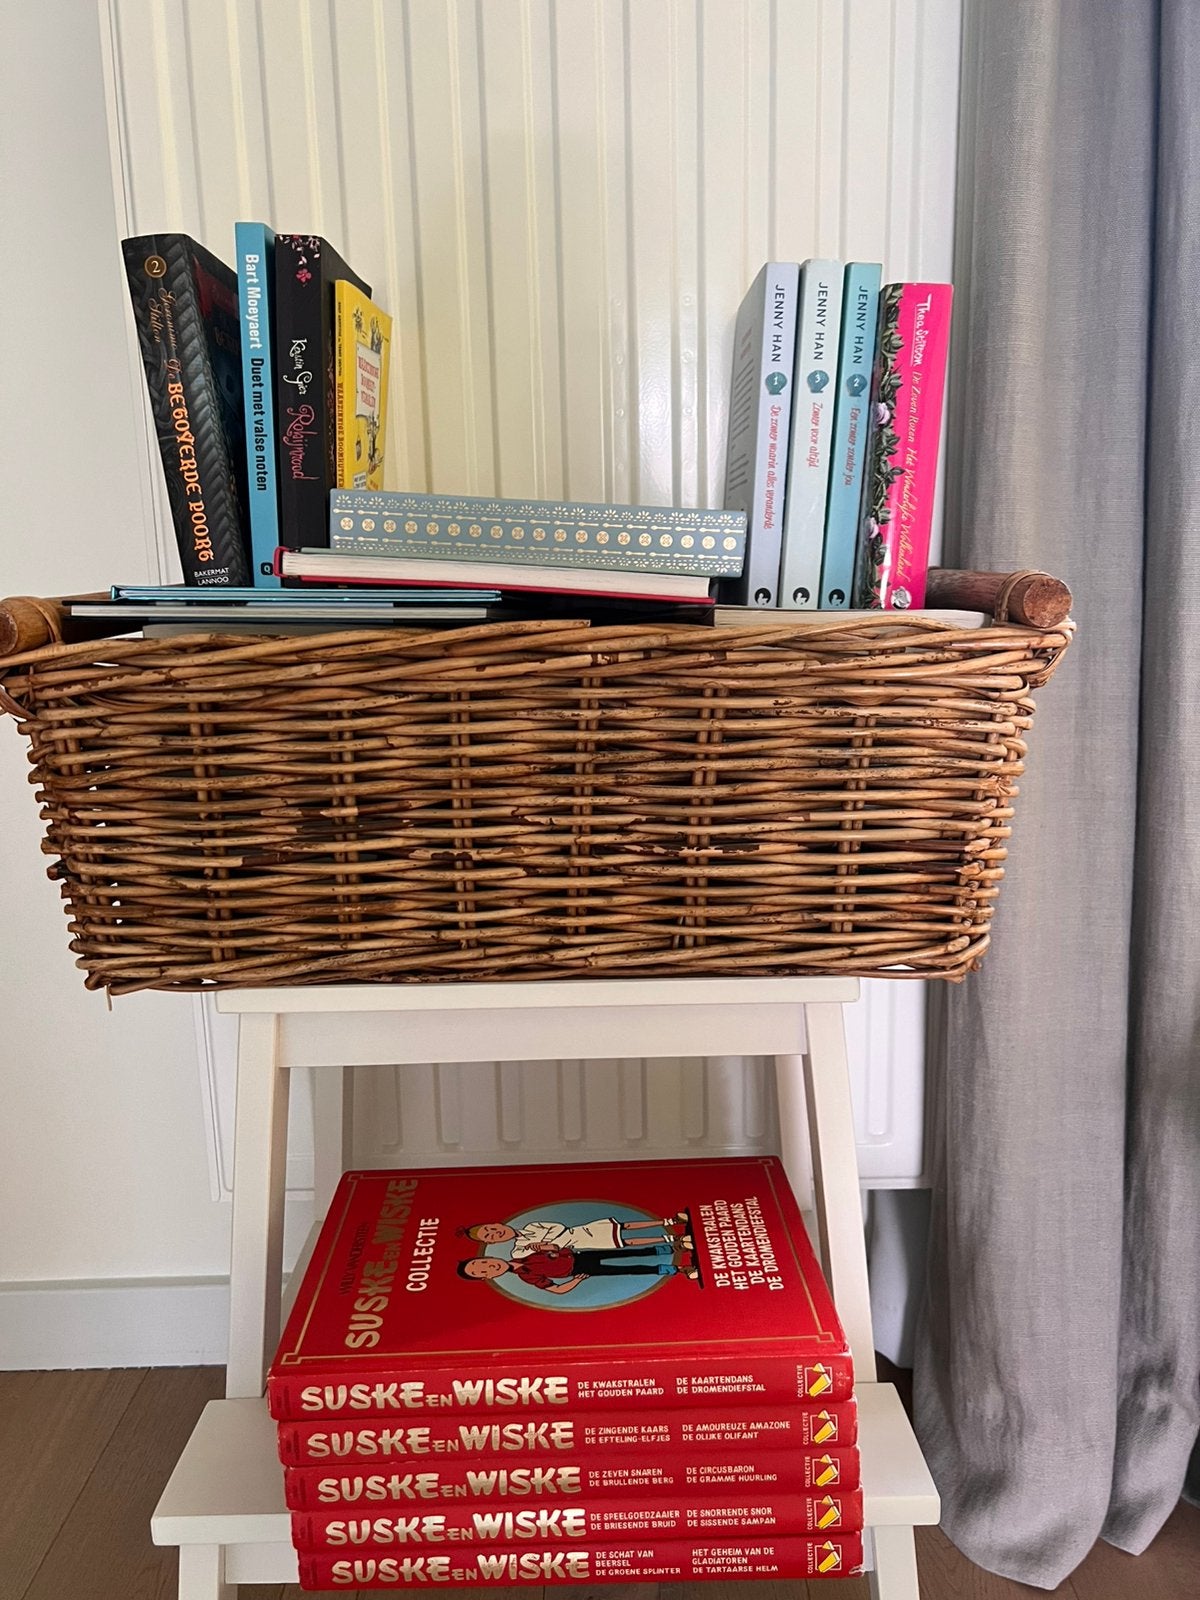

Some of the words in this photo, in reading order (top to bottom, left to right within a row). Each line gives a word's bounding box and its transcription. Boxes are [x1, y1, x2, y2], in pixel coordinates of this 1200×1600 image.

[152, 260, 161, 273] 2
[246, 254, 259, 283] Bart
[773, 284, 785, 329] JENNY
[816, 282, 828, 327] JENNY
[856, 286, 868, 331] JENNY
[916, 293, 932, 329] Thea
[246, 286, 262, 350] Moeyaert
[772, 334, 782, 362] HAN
[814, 332, 825, 360] HAN
[853, 336, 864, 364] HAN
[913, 329, 929, 367] Stilton
[251, 358, 264, 386] Duet
[283, 371, 313, 395] Gier
[912, 371, 922, 385] De
[252, 388, 265, 416] met
[770, 405, 781, 417] De
[811, 402, 823, 426] Zomer
[850, 407, 861, 420] Een
[253, 418, 267, 456] valse
[283, 404, 320, 480] Robijnrood
[769, 418, 778, 444] zomer
[811, 428, 820, 446] voor
[848, 422, 858, 445] zomer
[768, 443, 778, 469] waarin
[806, 446, 820, 468] altijd
[846, 447, 855, 475] zonder
[906, 447, 918, 465] Het
[256, 458, 267, 491] noten
[767, 470, 778, 488] alles
[843, 475, 854, 486] jou
[764, 489, 775, 529] veranderde
[188, 500, 214, 562] POORT
[194, 567, 229, 577] BAKERMAT
[198, 576, 229, 586] LANNOO
[714, 1199, 732, 1228] PAARD
[699, 1204, 727, 1270] KWAKSTRALEN
[730, 1203, 760, 1267] KAARTENDANS
[745, 1196, 779, 1273] DROMENDIEFSTAL
[405, 1218, 440, 1292] COLLECTIE
[721, 1230, 743, 1268] GOUDEN
[344, 1260, 398, 1349] SUSKE
[372, 1179, 418, 1245] WISKE
[714, 1272, 731, 1288] DE
[731, 1270, 749, 1290] HET
[748, 1270, 766, 1285] DE
[766, 1276, 785, 1291] DE
[577, 1381, 590, 1390] DE
[592, 1378, 656, 1389] KWAKSTRALEN
[676, 1377, 688, 1385] DE
[691, 1375, 754, 1385] KAARTENDANS
[676, 1386, 689, 1394] DE
[691, 1384, 766, 1393] DROMENDIEFSTAL
[300, 1381, 425, 1412] SUSKE
[425, 1394, 453, 1408] EN
[452, 1376, 569, 1406] WISKE
[578, 1390, 595, 1398] HET
[597, 1388, 633, 1398] GOUDEN
[635, 1387, 665, 1396] PAARD
[585, 1427, 596, 1436] DE
[598, 1426, 639, 1435] ZINGENDE
[641, 1425, 669, 1433] KAARS
[682, 1424, 693, 1432] DE
[695, 1422, 747, 1432] AMOUREUZE
[750, 1421, 791, 1430] AMAZONE
[682, 1433, 693, 1441] DE
[695, 1432, 722, 1441] OLIJKE
[724, 1432, 759, 1440] OLIFANT
[307, 1427, 431, 1458] SUSKE
[432, 1439, 459, 1452] EN
[458, 1421, 575, 1451] WISKE
[585, 1436, 596, 1445] DE
[599, 1434, 671, 1444] EFTELING-ELFJES
[588, 1471, 600, 1479] DE
[602, 1469, 629, 1478] ZEVEN
[631, 1468, 663, 1477] SNAREN
[686, 1466, 697, 1475] DE
[699, 1465, 755, 1474] CIRCUSBARON
[686, 1476, 697, 1484] DE
[699, 1475, 736, 1483] GRAMME
[738, 1473, 778, 1482] HUURLING
[317, 1472, 440, 1503] SUSKE
[440, 1484, 467, 1498] EN
[466, 1466, 582, 1497] WISKE
[589, 1479, 600, 1487] DE
[602, 1477, 650, 1486] BRULLENDE
[652, 1476, 674, 1484] BERG
[590, 1513, 601, 1521] DE
[603, 1510, 680, 1520] SPEELGOEDZAAIER
[686, 1509, 698, 1518] DE
[700, 1508, 749, 1517] SNORRENDE
[750, 1507, 773, 1516] SNOR
[700, 1518, 739, 1527] SISSENDE
[741, 1517, 776, 1525] SAMPAN
[325, 1515, 446, 1546] SUSKE
[447, 1527, 473, 1541] EN
[471, 1508, 587, 1540] WISKE
[604, 1521, 649, 1530] BRIESENDE
[651, 1520, 677, 1528] BRUID
[595, 1551, 607, 1559] DE
[609, 1550, 635, 1559] SCHAT
[637, 1550, 654, 1558] VAN
[692, 1557, 748, 1565] GLADIATOREN
[711, 1548, 742, 1556] GEHEIM
[763, 1547, 775, 1555] DE
[331, 1555, 451, 1584] SUSKE
[451, 1568, 478, 1581] EN
[477, 1551, 590, 1581] WISKE
[608, 1568, 641, 1576] GROENE
[643, 1567, 681, 1575] SPLINTER
[693, 1566, 703, 1574] DE
[706, 1565, 753, 1573] TARTAARSE
